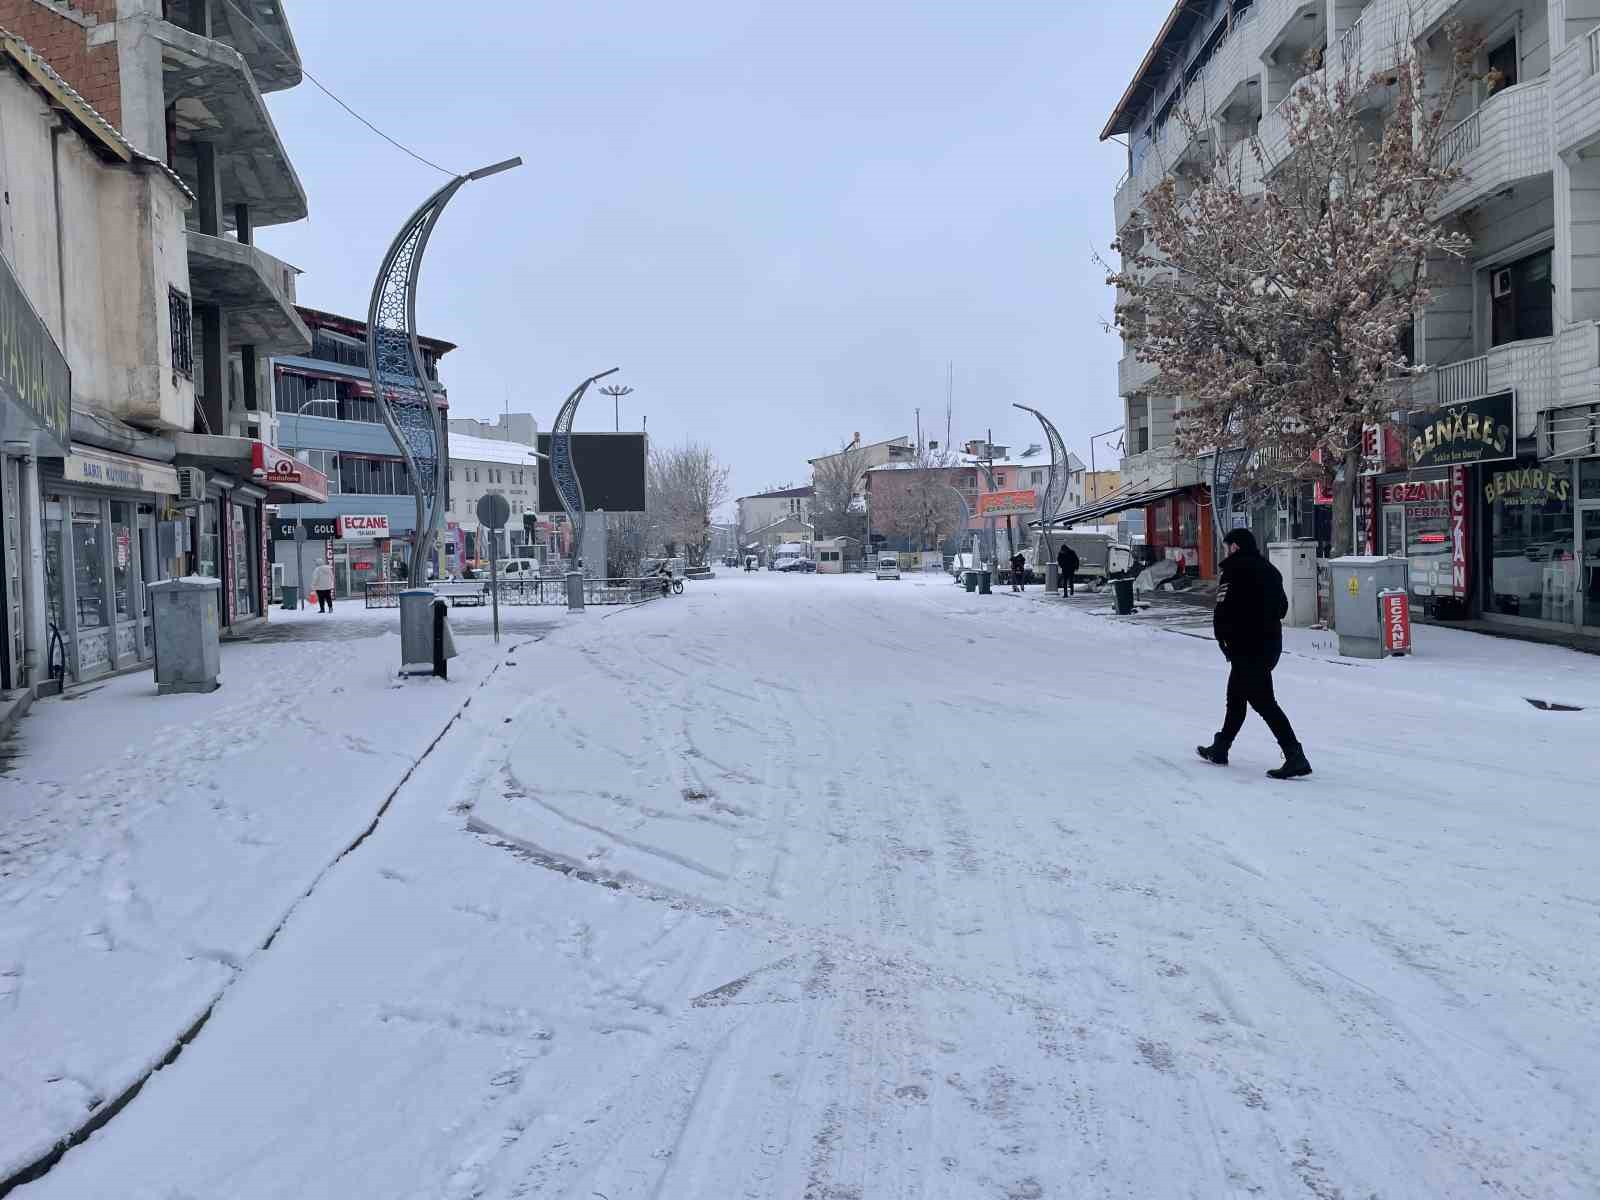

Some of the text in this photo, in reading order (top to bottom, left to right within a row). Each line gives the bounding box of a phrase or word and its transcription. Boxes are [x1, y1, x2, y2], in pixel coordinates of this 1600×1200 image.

[1411, 412, 1510, 464] BENARES
[1484, 468, 1570, 504] BENARES
[345, 517, 387, 528] ECZANE
[1391, 597, 1404, 649] ECZANE
